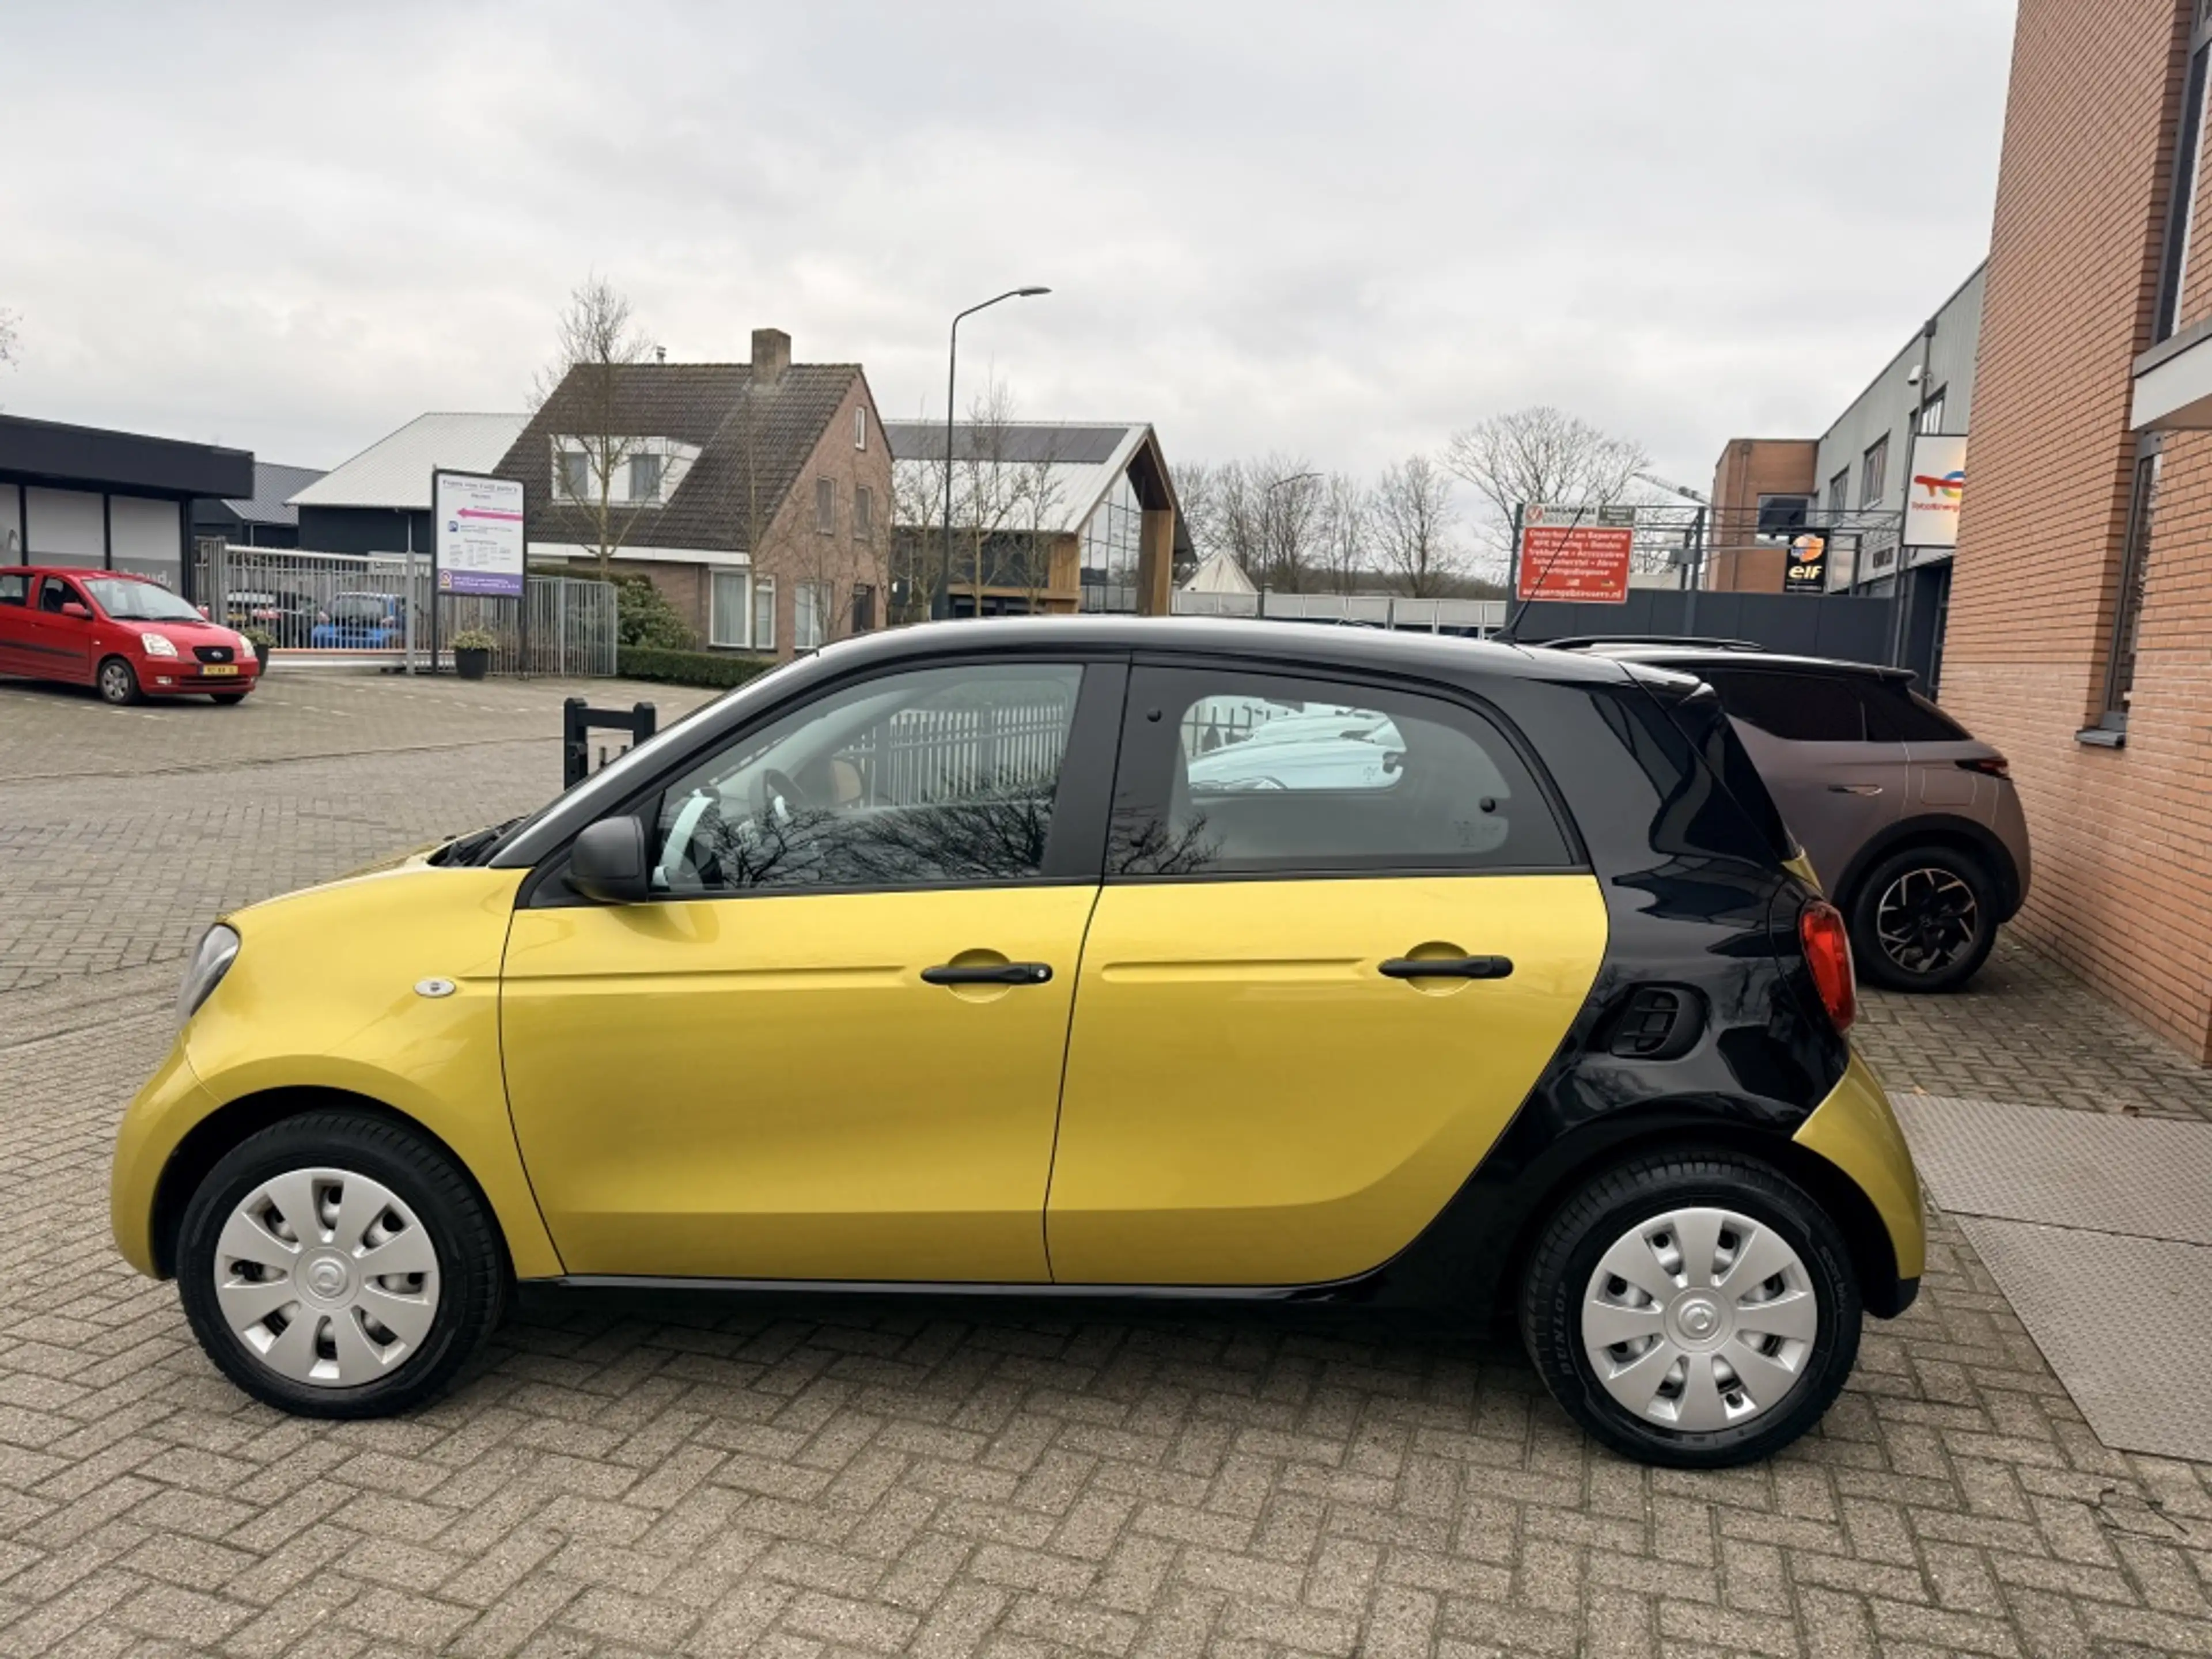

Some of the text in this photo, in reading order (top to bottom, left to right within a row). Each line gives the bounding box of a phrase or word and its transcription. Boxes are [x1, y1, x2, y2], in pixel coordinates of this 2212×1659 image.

[1911, 501, 1960, 512] TotalEnerg
[1529, 529, 1573, 539] Onderhod
[1551, 541, 1582, 550] kering
[1529, 548, 1569, 556] Trekhaen
[1789, 565, 1823, 579] elf
[1553, 1281, 1574, 1375] DUNLOP
